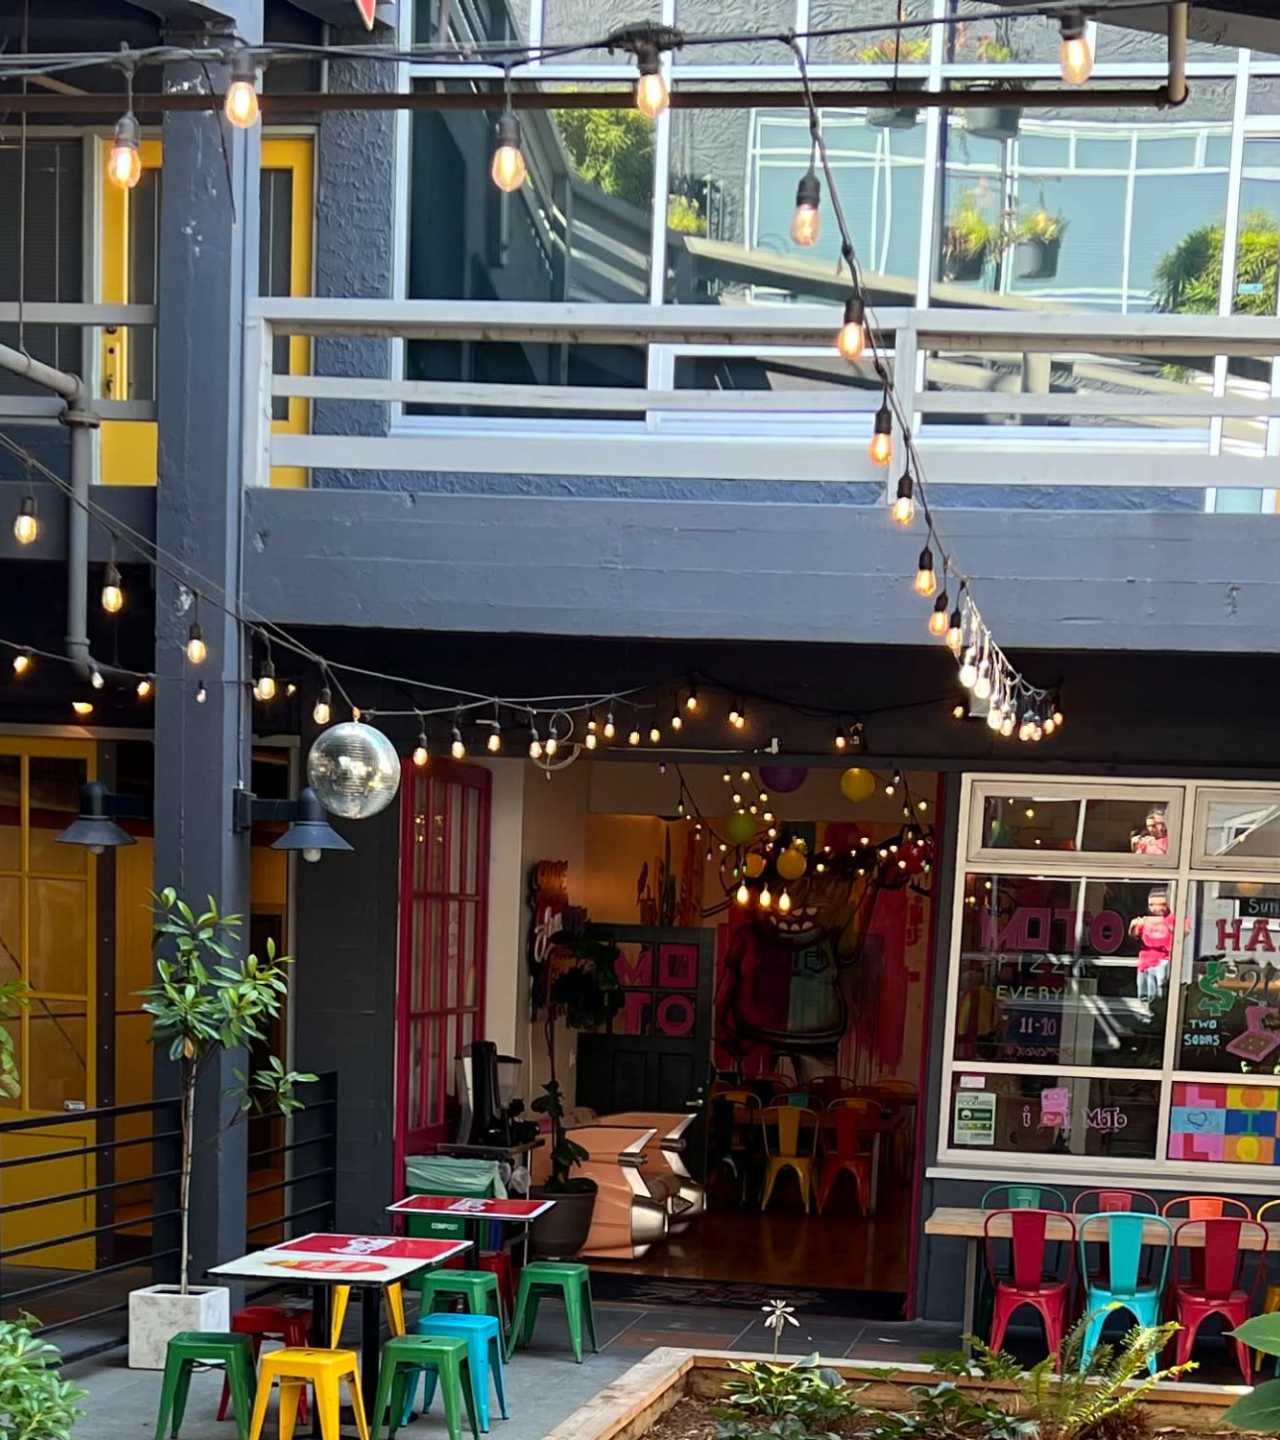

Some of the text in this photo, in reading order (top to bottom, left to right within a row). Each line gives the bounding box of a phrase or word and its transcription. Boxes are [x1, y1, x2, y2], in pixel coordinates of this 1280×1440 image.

[979, 907, 1125, 953] MOTO
[998, 953, 1088, 976] PIZZA
[1019, 1016, 1057, 1036] 11-10
[1188, 1019, 1217, 1029] TWO
